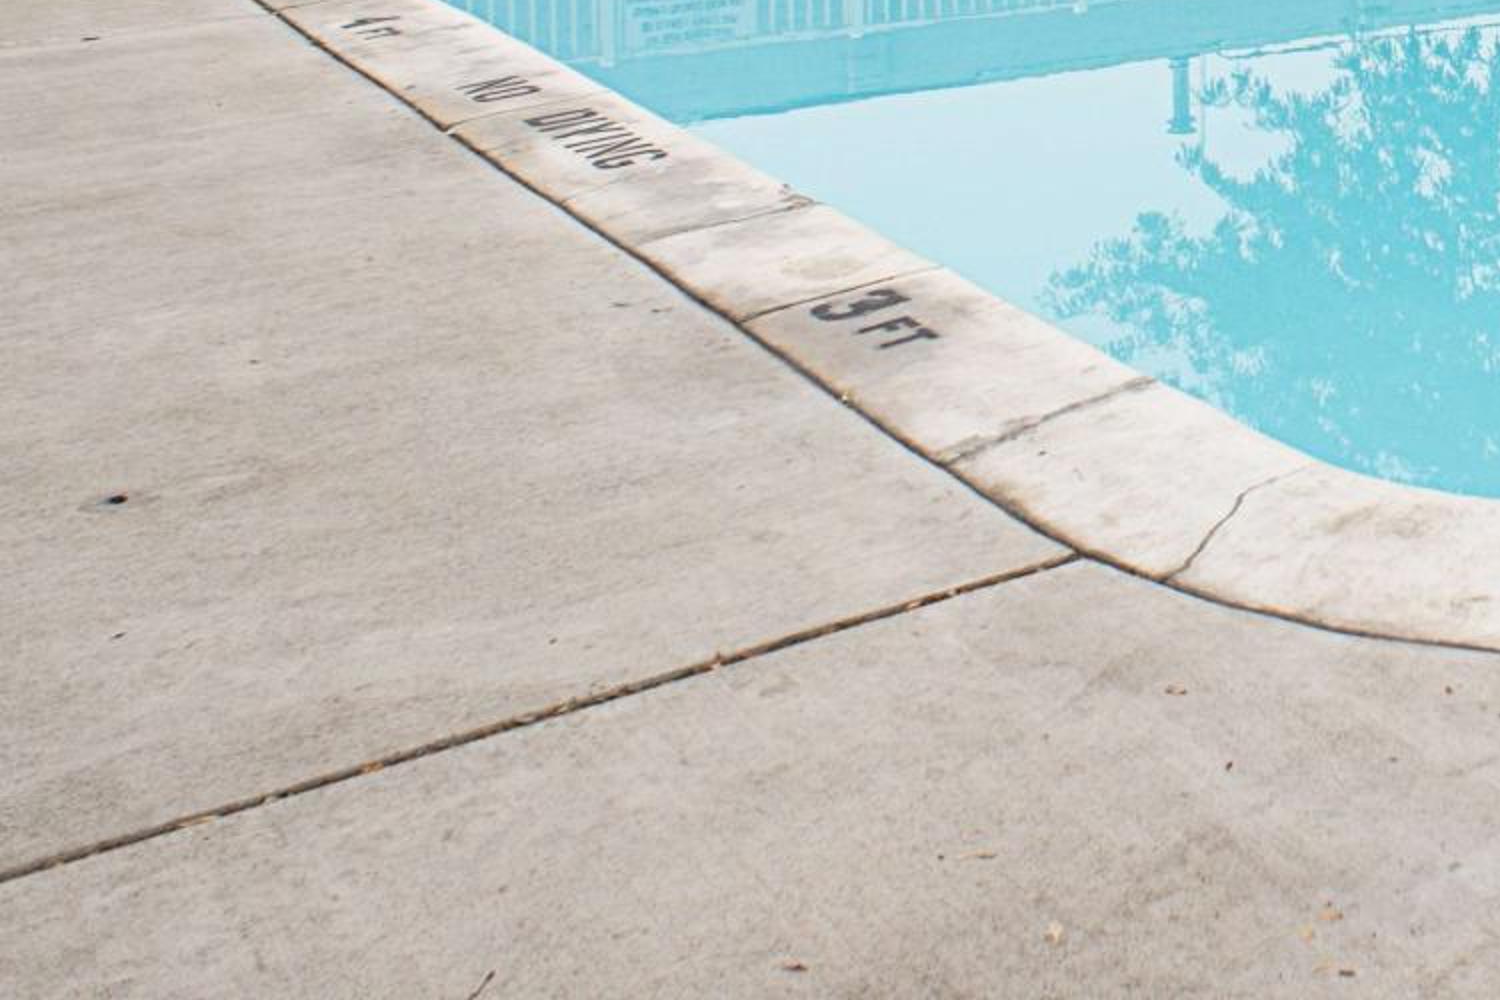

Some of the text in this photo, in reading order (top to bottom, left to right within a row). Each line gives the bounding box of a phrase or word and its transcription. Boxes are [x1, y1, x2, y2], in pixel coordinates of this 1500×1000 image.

[453, 75, 668, 169] NO DIVING
[809, 289, 940, 349] 3 FT
